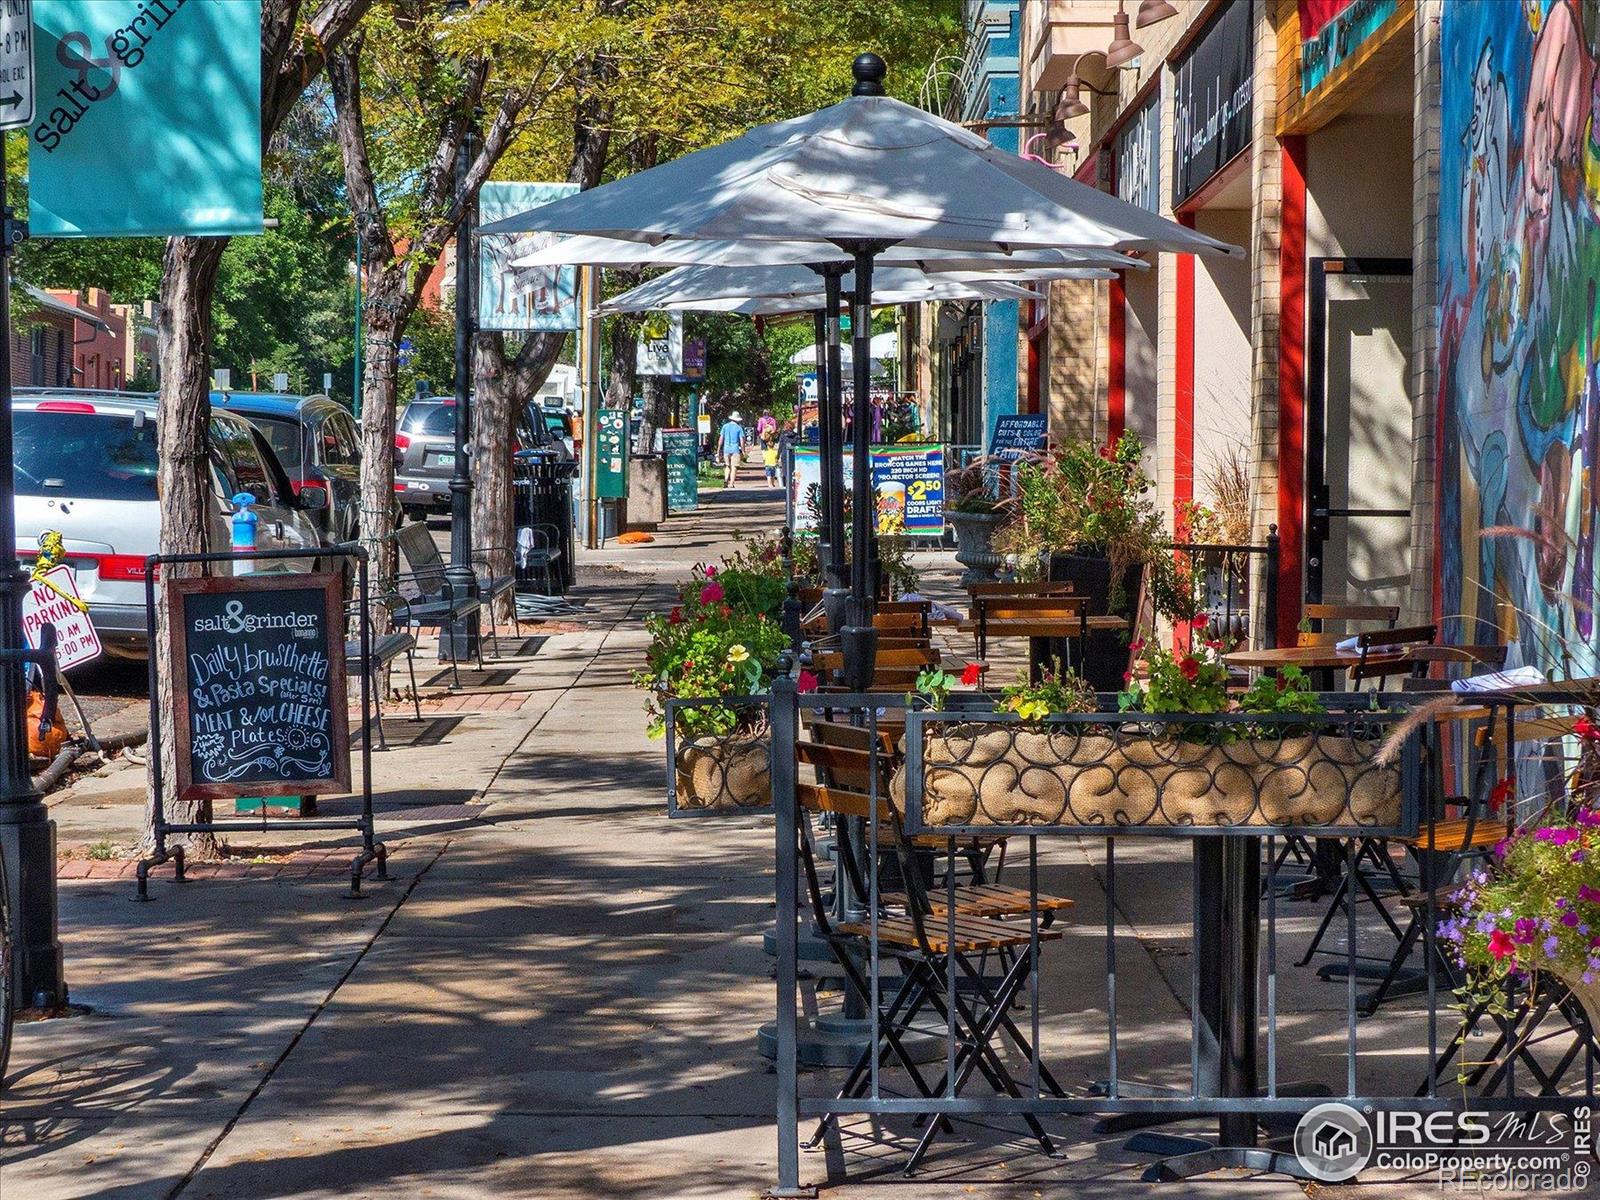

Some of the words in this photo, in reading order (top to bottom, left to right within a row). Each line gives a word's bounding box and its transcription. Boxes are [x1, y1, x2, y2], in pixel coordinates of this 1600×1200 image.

[14, 30, 27, 52] PM
[648, 344, 669, 353] Live
[1000, 420, 1044, 428] AFFORDABLE
[33, 585, 56, 607] NO
[66, 623, 81, 638] AM
[80, 634, 94, 654] PM
[190, 644, 241, 686] Daily
[193, 688, 214, 708] &
[210, 680, 255, 706] Pasta
[195, 710, 234, 733] MEAT
[280, 702, 330, 732] CHEESE
[231, 727, 284, 748] Plates
